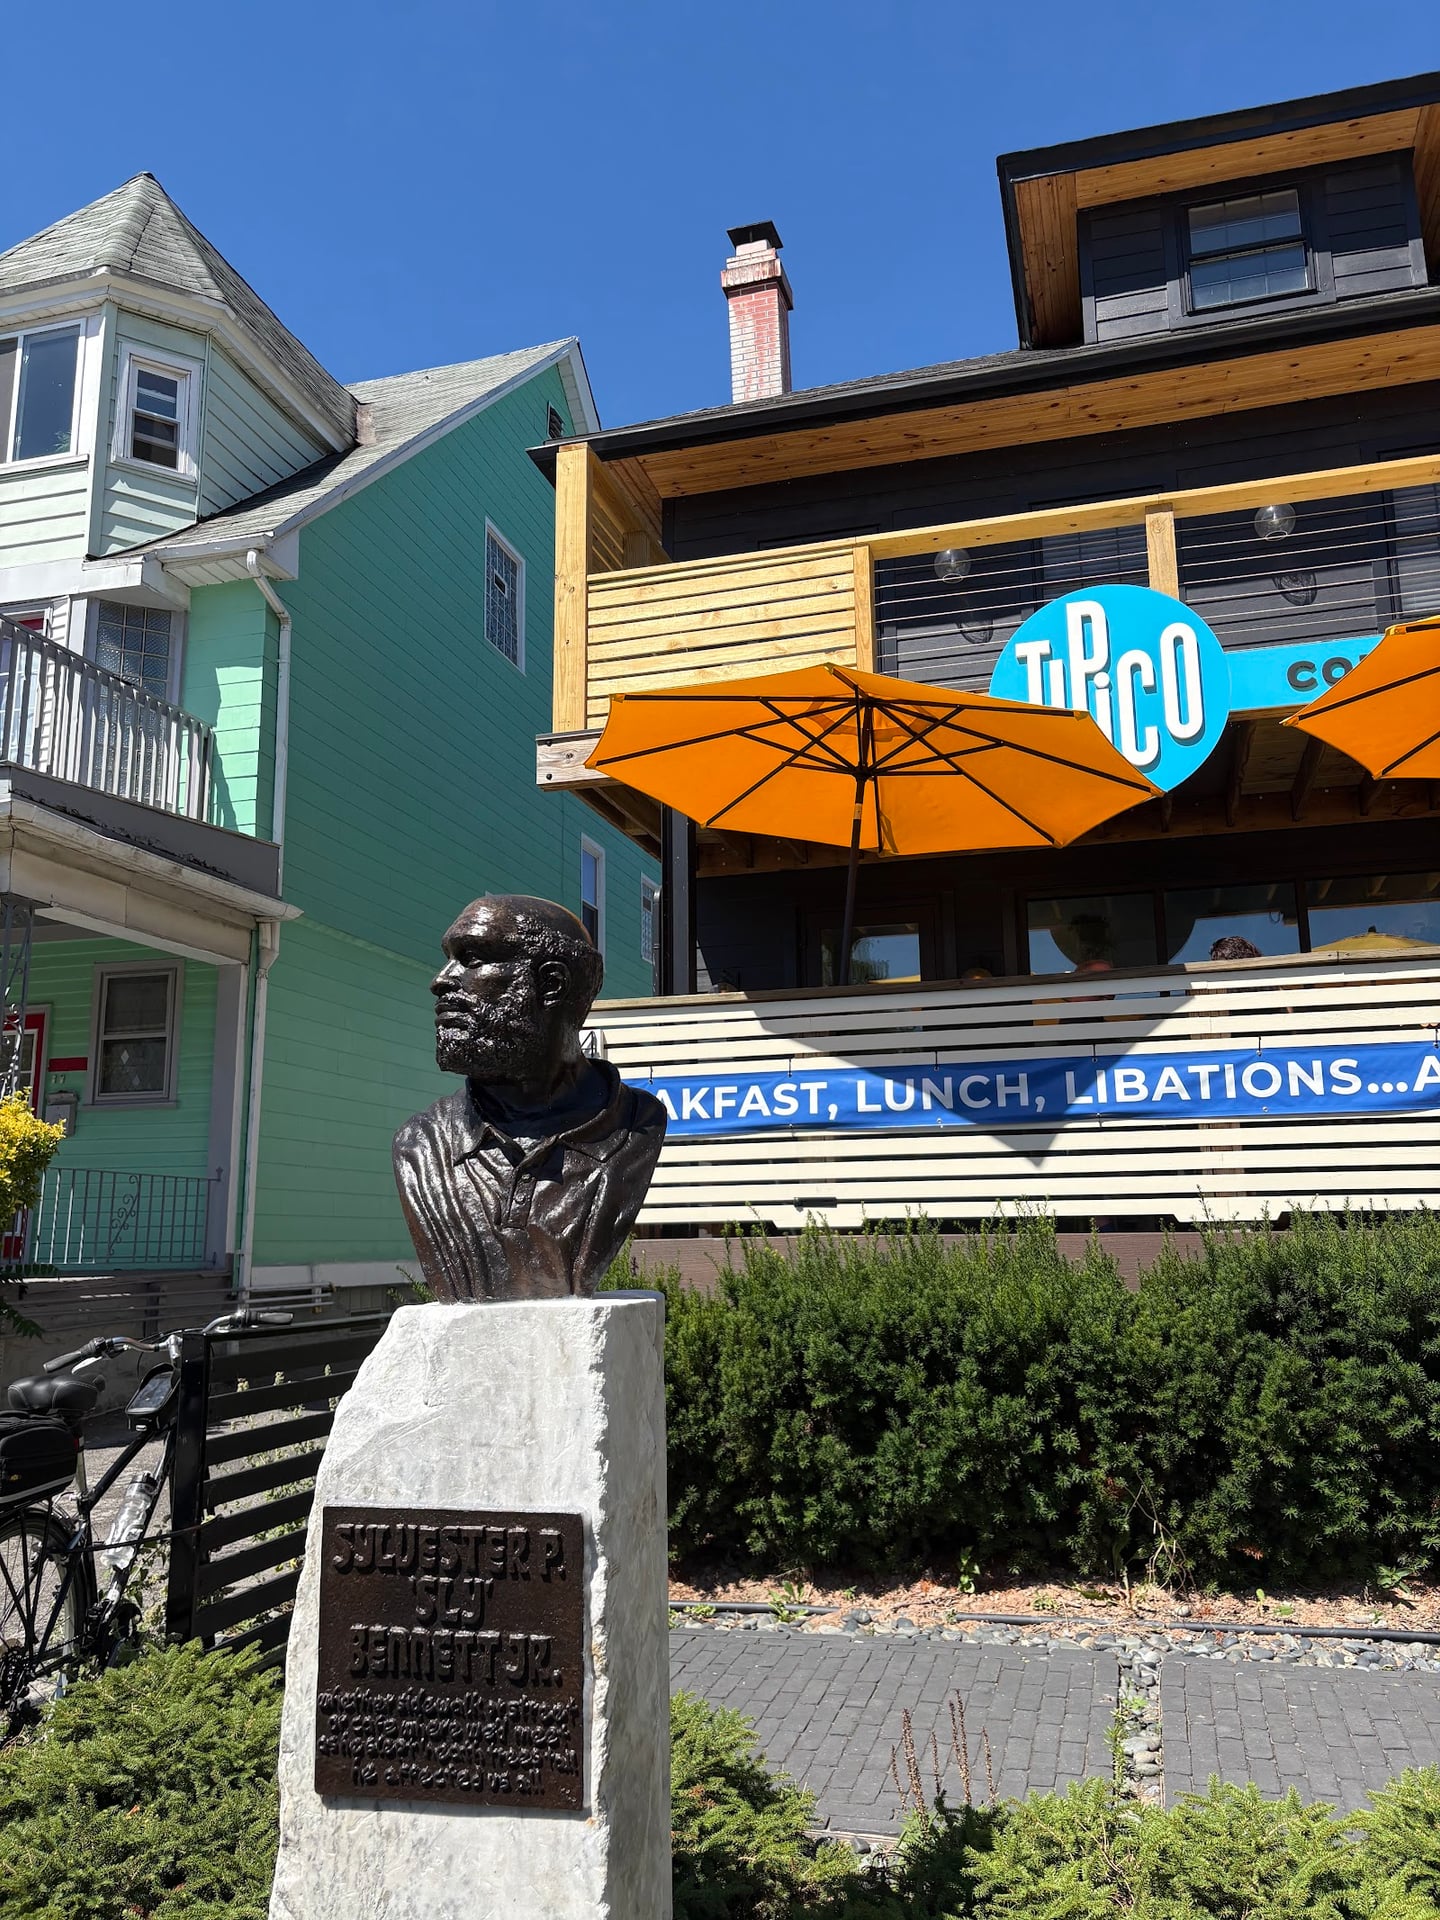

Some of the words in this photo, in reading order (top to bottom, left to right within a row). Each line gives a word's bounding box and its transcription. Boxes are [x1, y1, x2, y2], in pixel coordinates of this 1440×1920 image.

[856, 1072, 1046, 1113] LUNCH,
[332, 1524, 531, 1578] SYLVESTER
[539, 1528, 567, 1583] P.
[350, 1624, 501, 1682] BENNETT
[506, 1633, 562, 1687] JR.
